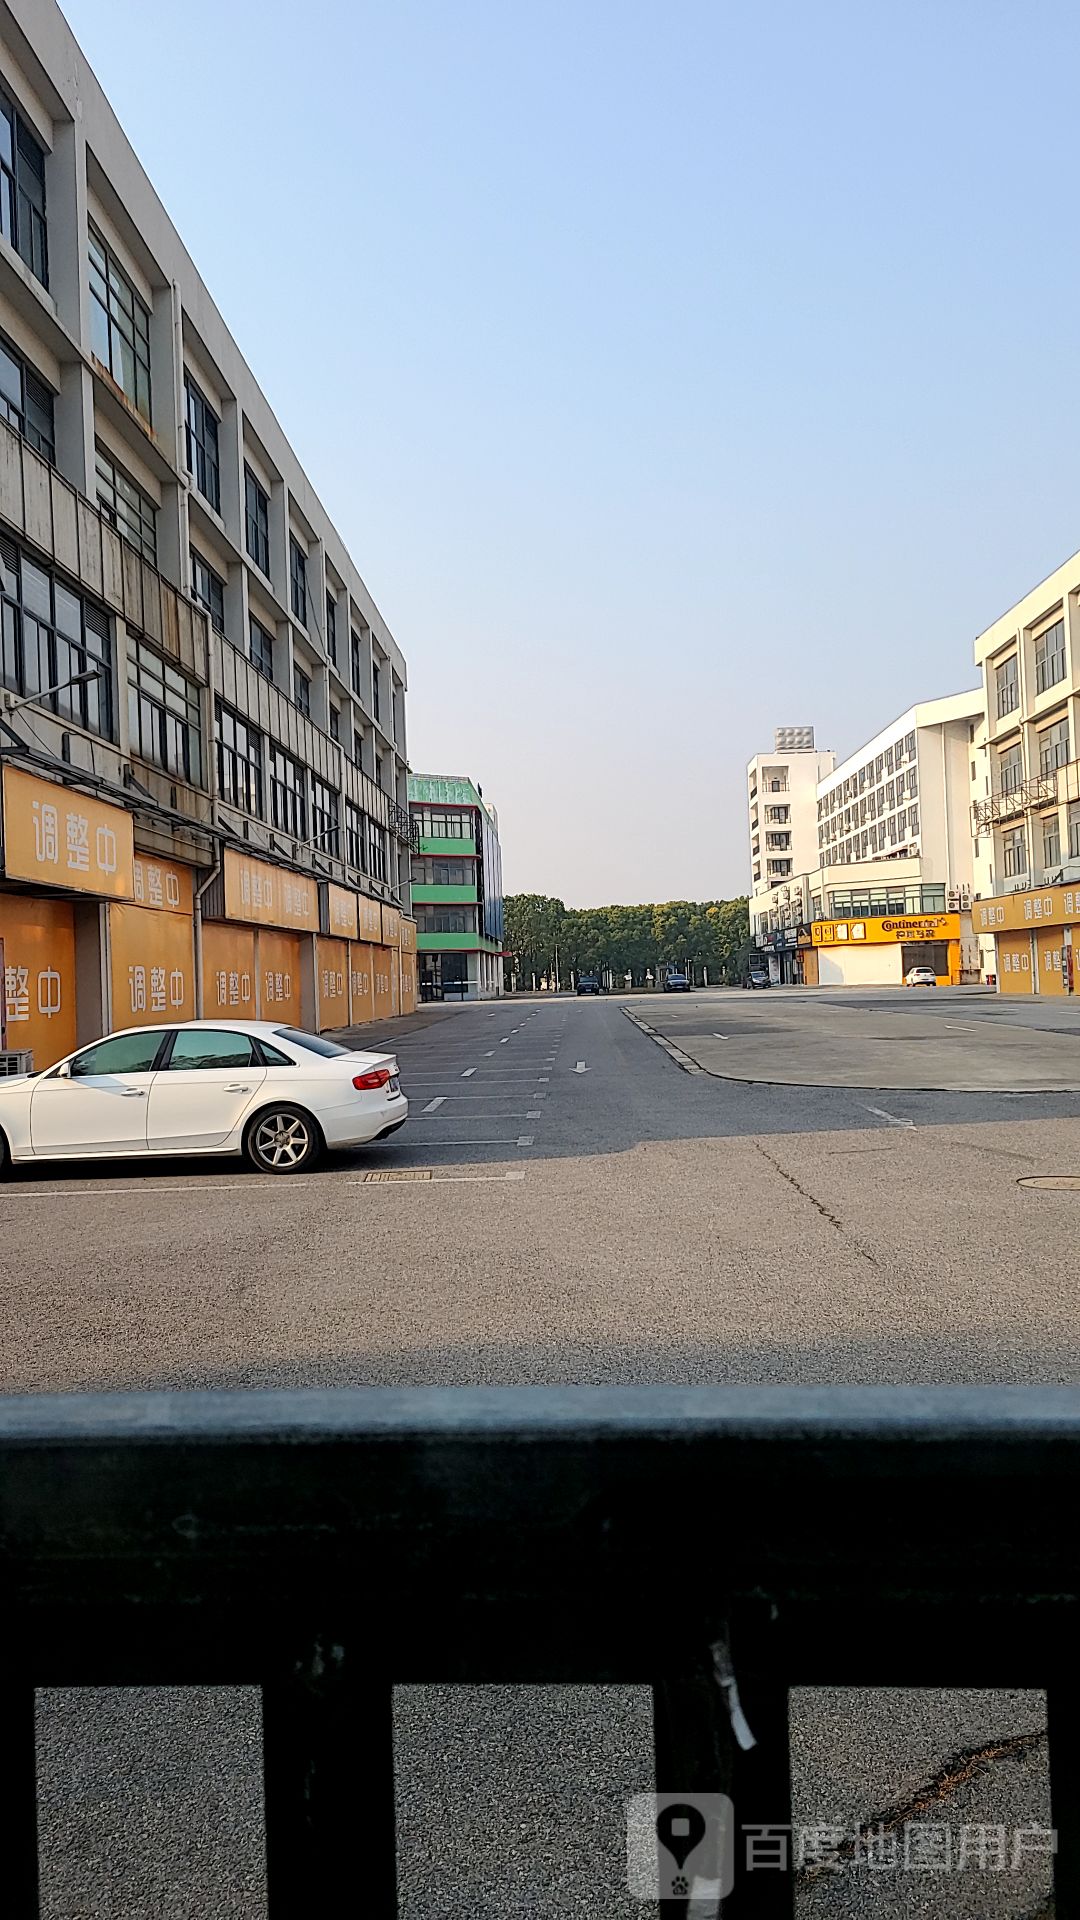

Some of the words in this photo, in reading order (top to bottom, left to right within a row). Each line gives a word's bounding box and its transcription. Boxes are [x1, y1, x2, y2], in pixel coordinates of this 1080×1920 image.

[32, 801, 117, 876] 调整中
[241, 866, 272, 910] 调整中
[882, 918, 938, 932] Continental
[980, 907, 1003, 926] 调整中
[1024, 897, 1052, 920] 调整中
[1003, 953, 1029, 973] 调整中
[128, 965, 184, 1013] 调整中
[216, 970, 250, 1006] 调整中
[266, 971, 291, 1002] 调整中
